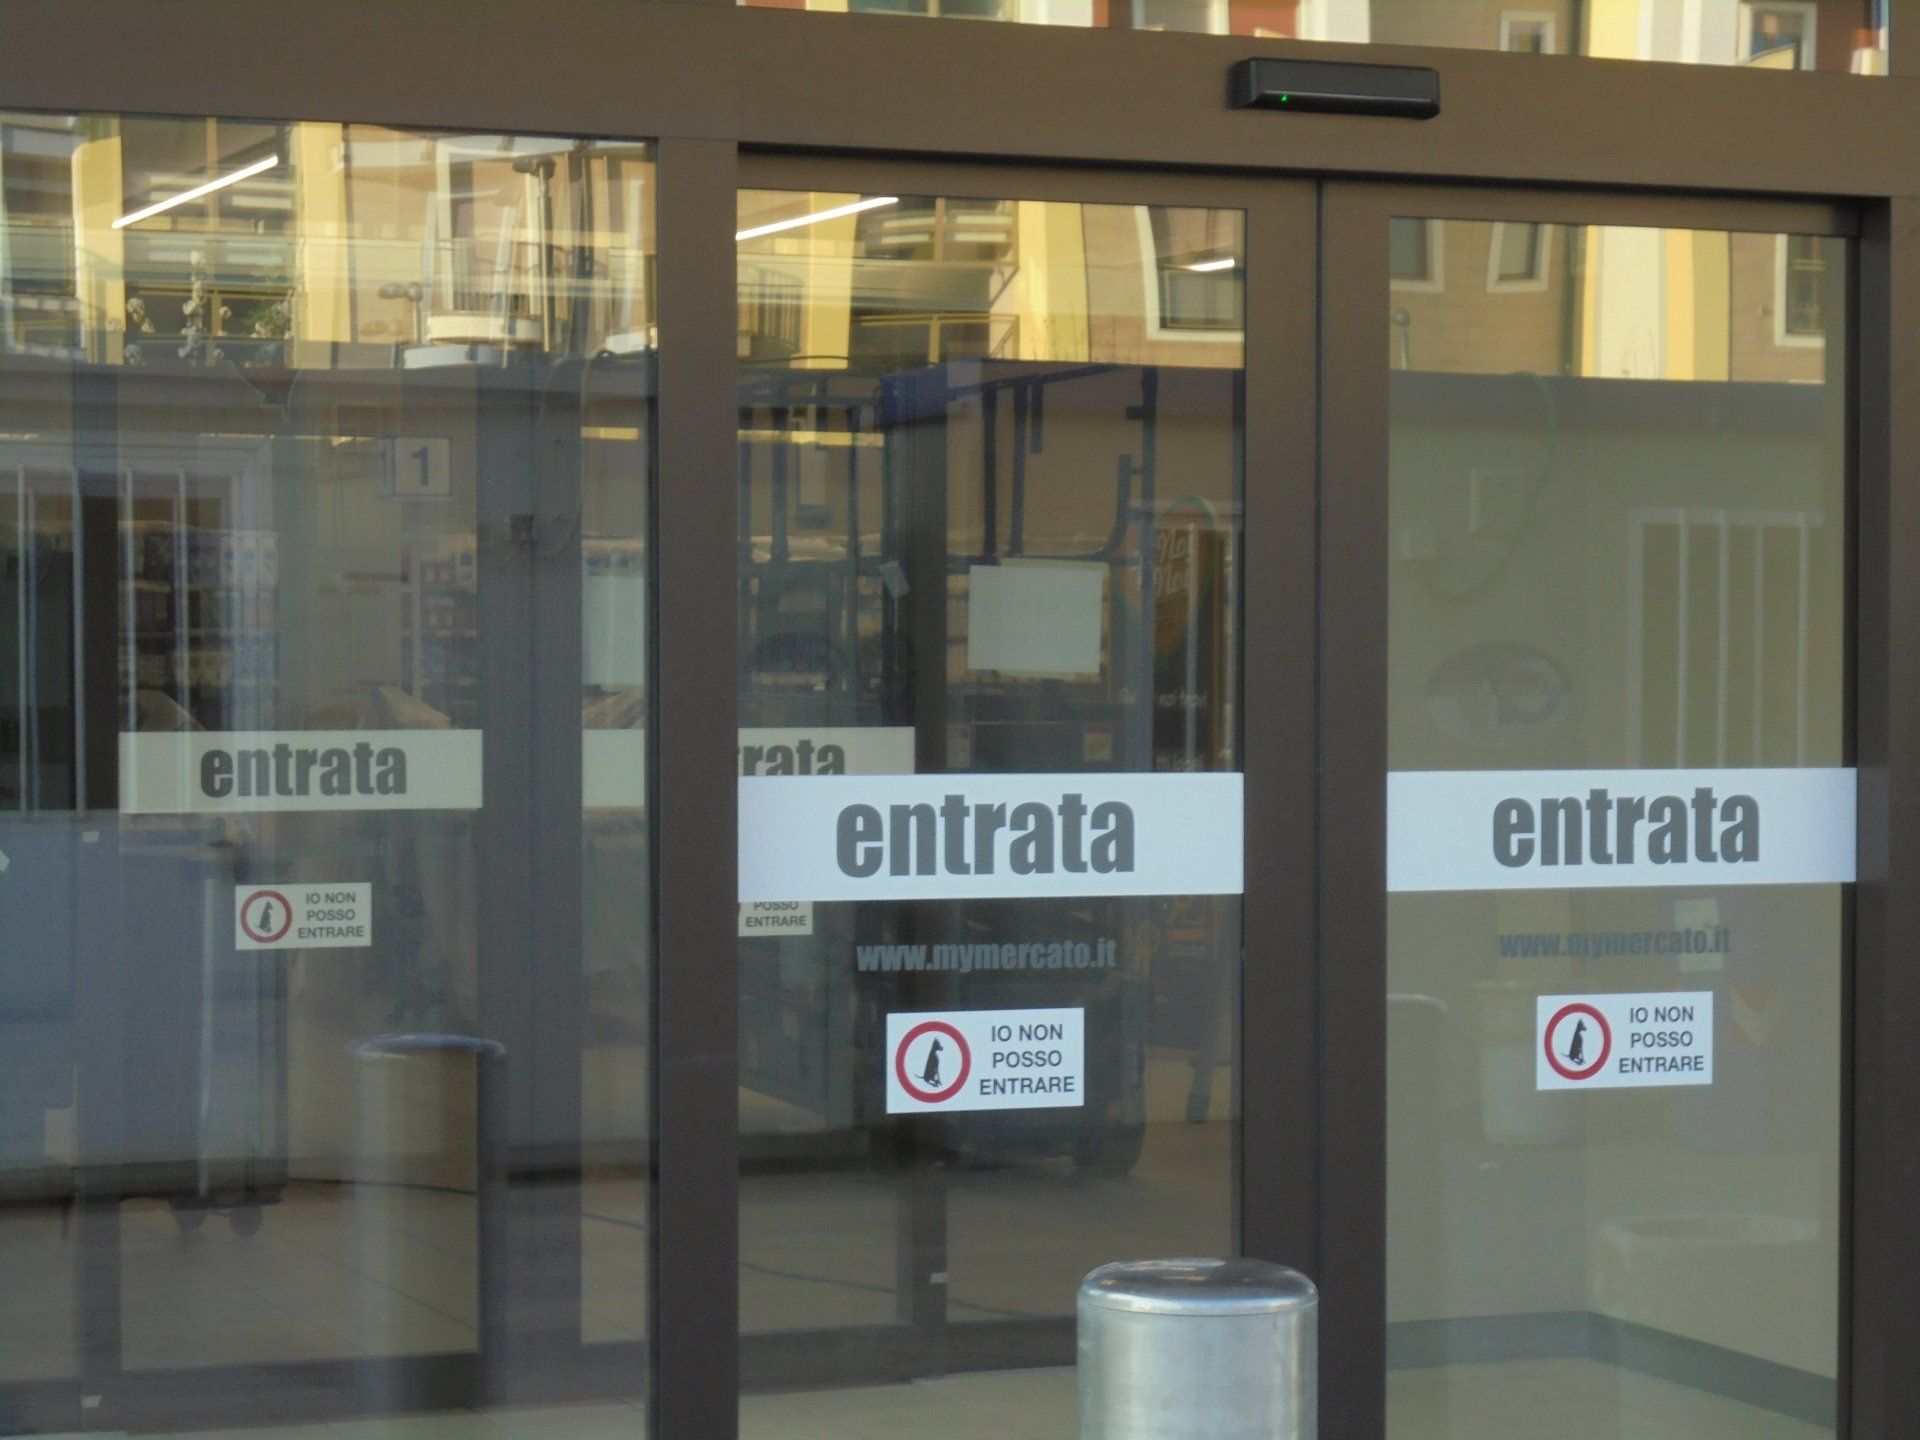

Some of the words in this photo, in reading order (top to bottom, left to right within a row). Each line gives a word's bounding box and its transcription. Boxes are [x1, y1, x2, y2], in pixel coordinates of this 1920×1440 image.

[738, 737, 846, 775] rata
[200, 742, 407, 798] entrata
[836, 793, 1135, 878] entrata
[1492, 787, 1760, 868] entrata
[305, 892, 321, 905] IO
[324, 891, 357, 904] NON
[306, 908, 356, 921] POSSO
[745, 914, 808, 928] ENTRARE
[297, 925, 365, 939] ENTRARE
[1498, 926, 1731, 960] www.mymercato.it
[856, 937, 1117, 973] www.mymercato.it
[1629, 1007, 1649, 1024] IO
[1654, 1006, 1695, 1023] NON
[991, 1025, 1013, 1042] IO
[1019, 1023, 1064, 1041] NON
[1630, 1030, 1694, 1049] POSSO
[992, 1049, 1063, 1068] POSSO
[1618, 1055, 1705, 1074] ENTRARE
[979, 1075, 1075, 1096] ENTRARE
